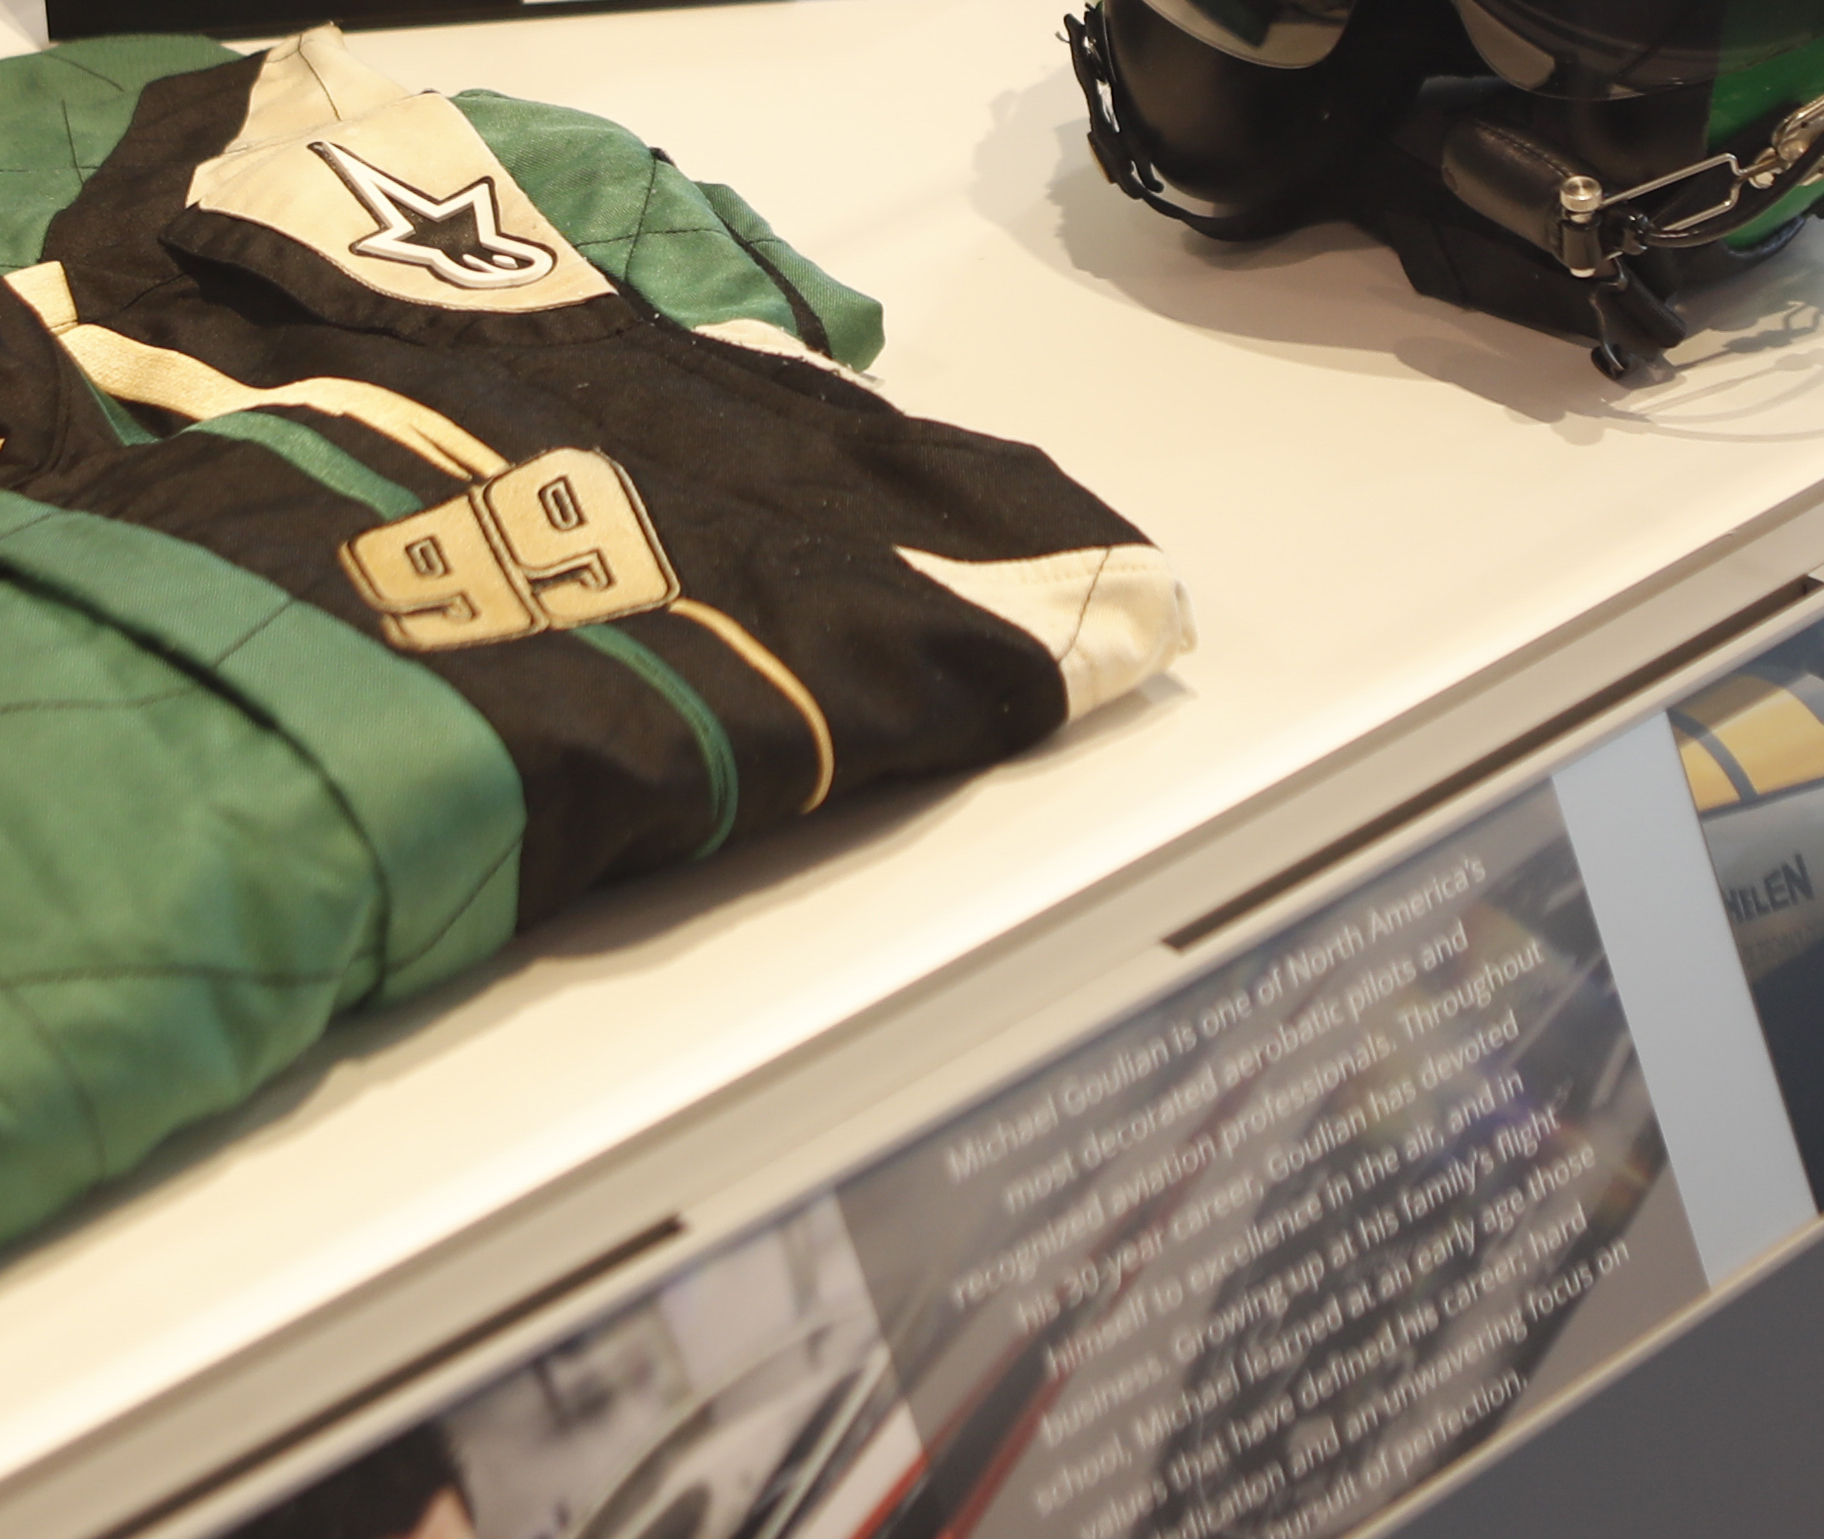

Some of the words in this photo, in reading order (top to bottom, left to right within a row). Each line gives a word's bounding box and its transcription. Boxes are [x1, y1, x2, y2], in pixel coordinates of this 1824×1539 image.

[337, 446, 680, 653] 99
[946, 1092, 1058, 1184] Michael
[1063, 1036, 1169, 1116] Goulian
[1172, 1020, 1197, 1055] is
[1203, 990, 1252, 1038] one
[1258, 964, 1283, 1006] of
[1286, 924, 1364, 988] North
[1370, 858, 1487, 943] America's
[953, 1191, 1104, 1308] recognized
[1112, 1134, 1216, 1214] aviation
[1399, 937, 1544, 1041] Throughout
[1005, 1148, 1078, 1214] most
[1083, 1064, 1218, 1168] decorated
[1225, 1004, 1344, 1089] aerobatic
[1347, 960, 1416, 1023] pilots
[1424, 917, 1468, 971] and
[1016, 1291, 1060, 1334] his
[1268, 1106, 1367, 1182] Goulian
[1368, 1076, 1416, 1122] has
[1421, 1009, 1519, 1090] devoted
[1133, 1360, 1240, 1450] Michael
[1241, 1294, 1344, 1383] learned
[1347, 1280, 1376, 1317] at
[1379, 1266, 1412, 1299] an
[1417, 1215, 1475, 1272] early
[1482, 1191, 1525, 1233] age
[1527, 1144, 1596, 1202] those
[1175, 1278, 1288, 1360] Growing
[1288, 1250, 1325, 1293] up
[1330, 1228, 1358, 1270] at
[1359, 1206, 1399, 1250] his
[1399, 1147, 1494, 1224] family's
[1495, 1102, 1561, 1161] flight
[1189, 1192, 1322, 1294] excellence
[1327, 1171, 1353, 1210] in
[1356, 1149, 1400, 1190] the
[1405, 1123, 1444, 1161] air,
[1448, 1083, 1496, 1135] and
[1499, 1070, 1524, 1103] in
[1229, 1391, 1295, 1454] have
[1300, 1321, 1397, 1410] defined
[1400, 1301, 1439, 1344] his
[1528, 1199, 1588, 1259] hard
[1292, 1417, 1339, 1478] and
[1346, 1405, 1379, 1443] an
[1380, 1308, 1527, 1415] unwavering
[1527, 1263, 1593, 1322] focus
[1595, 1241, 1629, 1276] on
